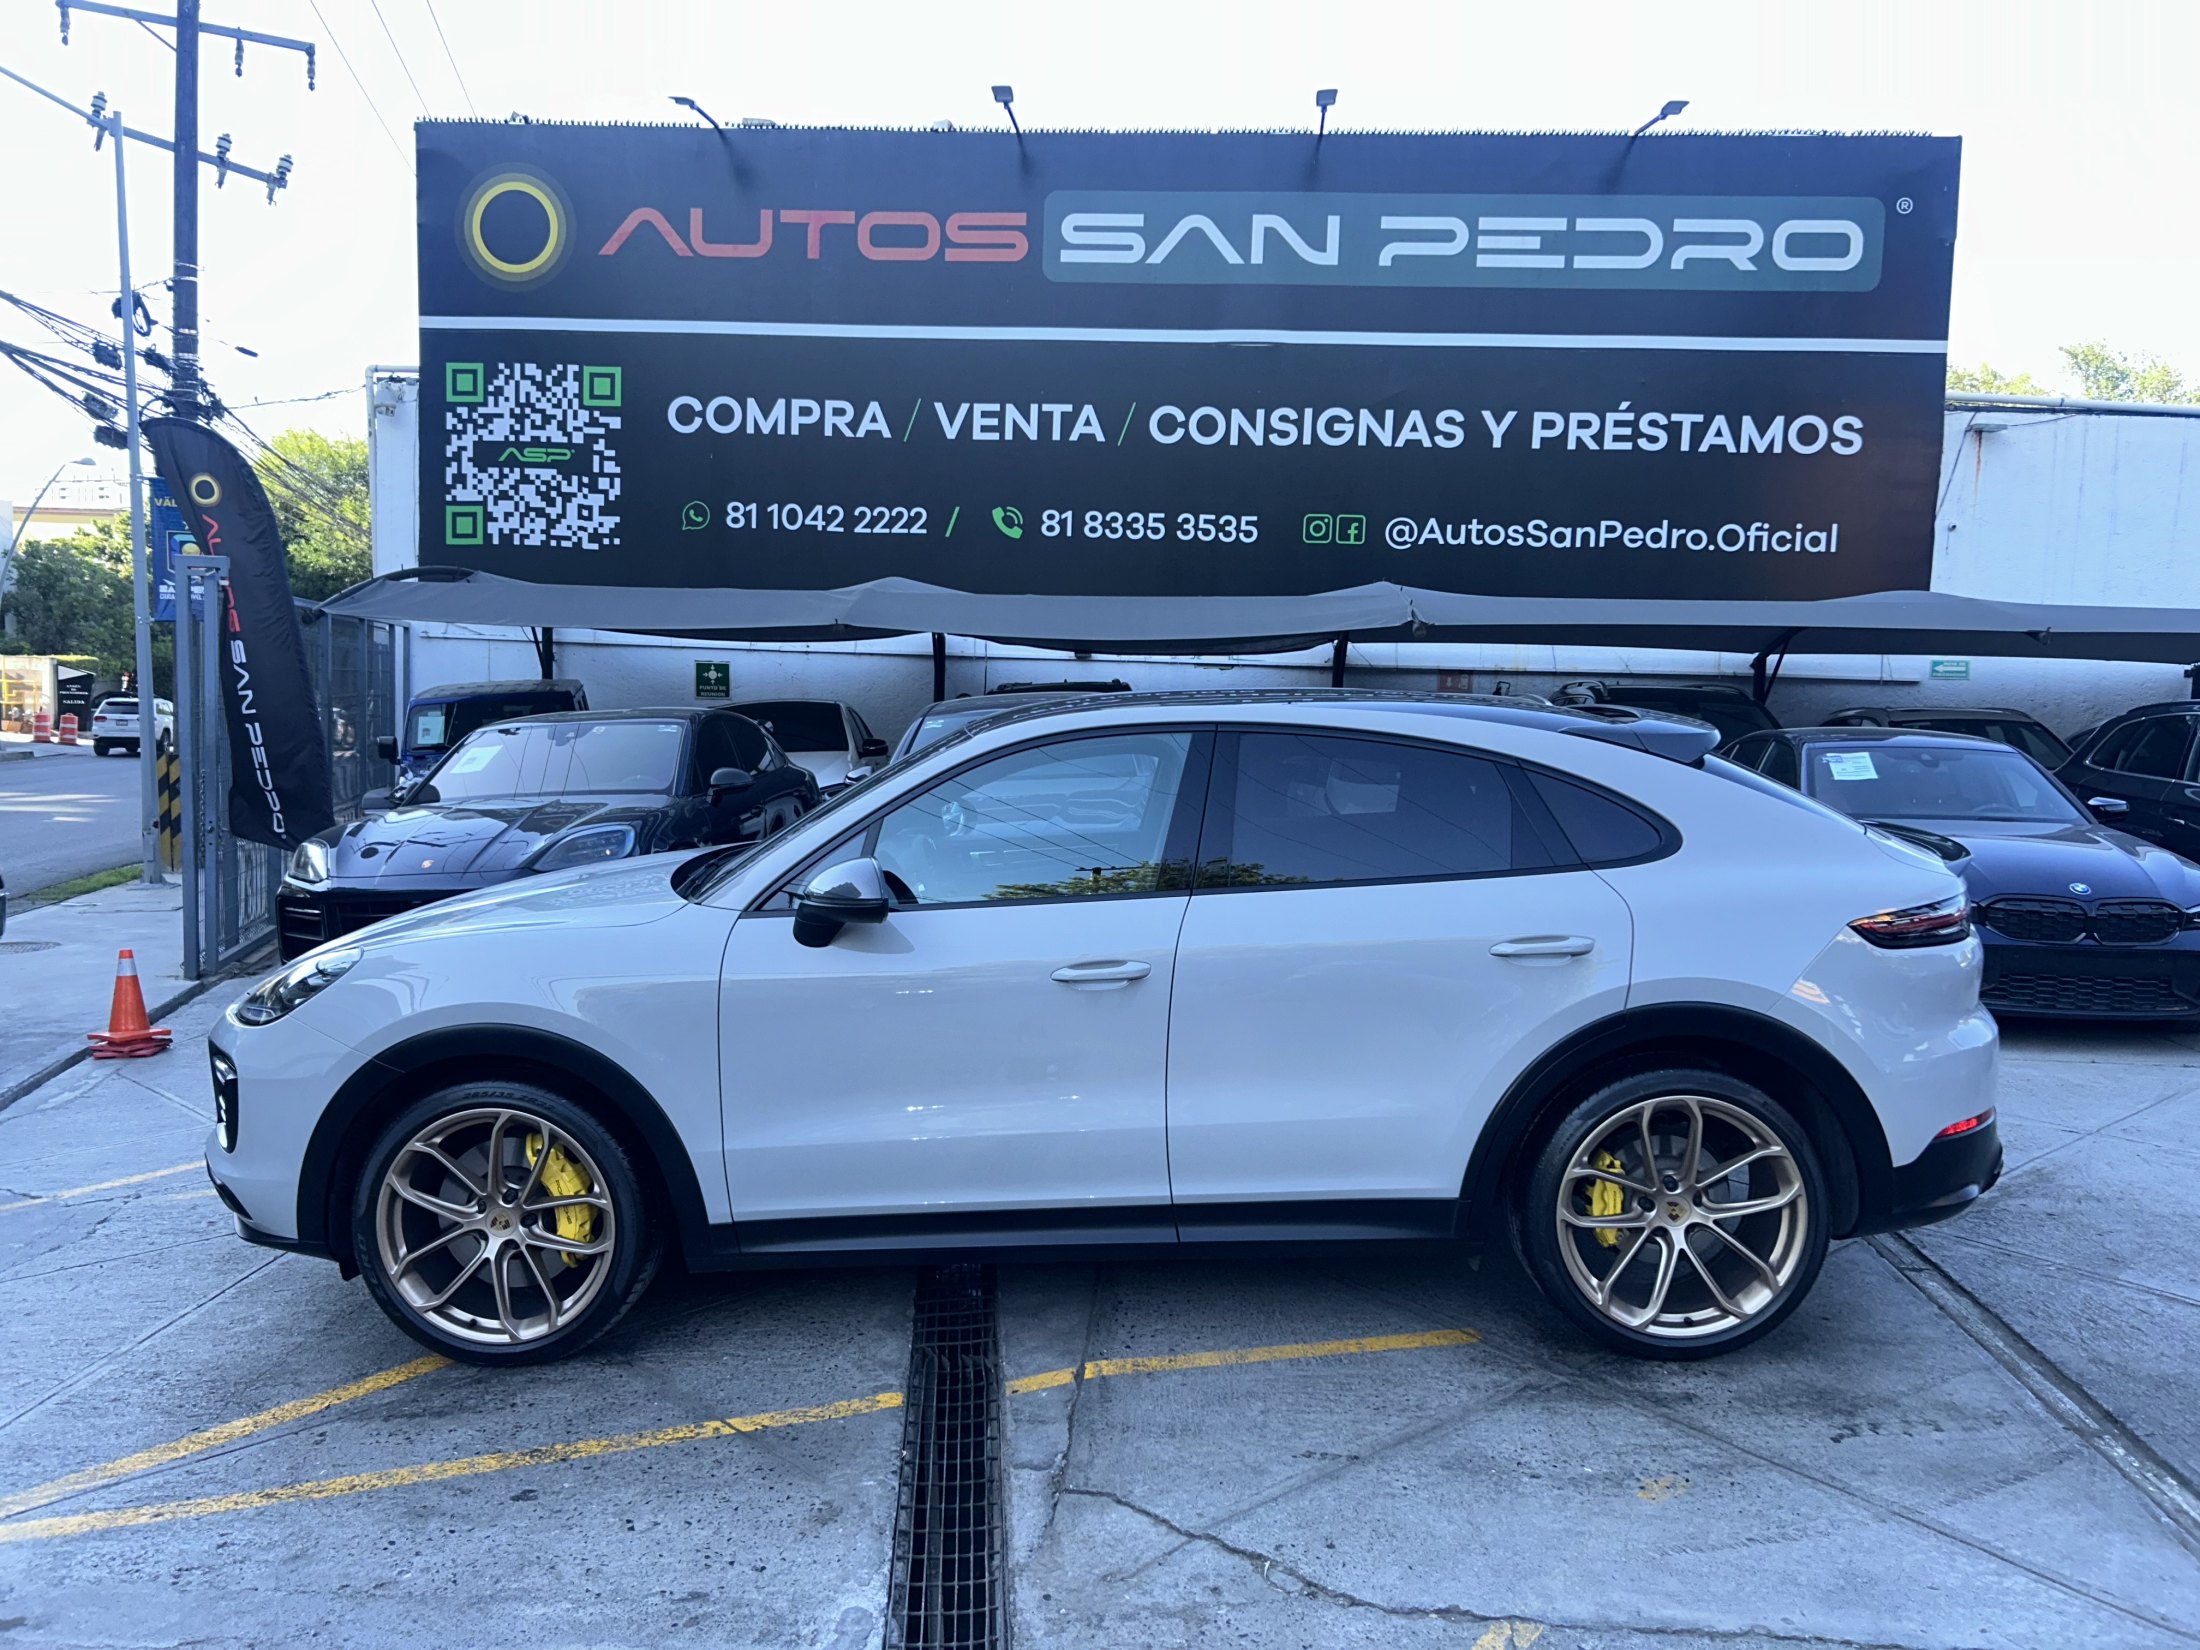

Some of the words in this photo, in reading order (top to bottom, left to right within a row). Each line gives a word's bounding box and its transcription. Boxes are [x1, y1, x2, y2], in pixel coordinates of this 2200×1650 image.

[598, 207, 1029, 262] AUTOS
[1060, 212, 1341, 267] SAN
[1377, 216, 1865, 272] PEDRO
[498, 447, 572, 462] ASP
[667, 395, 892, 438] COMPRA
[933, 402, 1106, 443] VENTA
[1149, 404, 1466, 449] CONSIGNAS
[1481, 410, 1519, 449] Y
[1531, 401, 1864, 456] PRÉSTAMOS
[726, 501, 757, 529] 81
[767, 503, 844, 532] 1042
[854, 506, 928, 534] 2222
[1041, 509, 1073, 537] 81
[1083, 510, 1166, 540] 8335
[1176, 513, 1259, 543] 3535
[1385, 516, 1839, 555] @AutosSanPedro.Oficial
[231, 639, 257, 714] SAN
[245, 722, 286, 833] PEDRO
